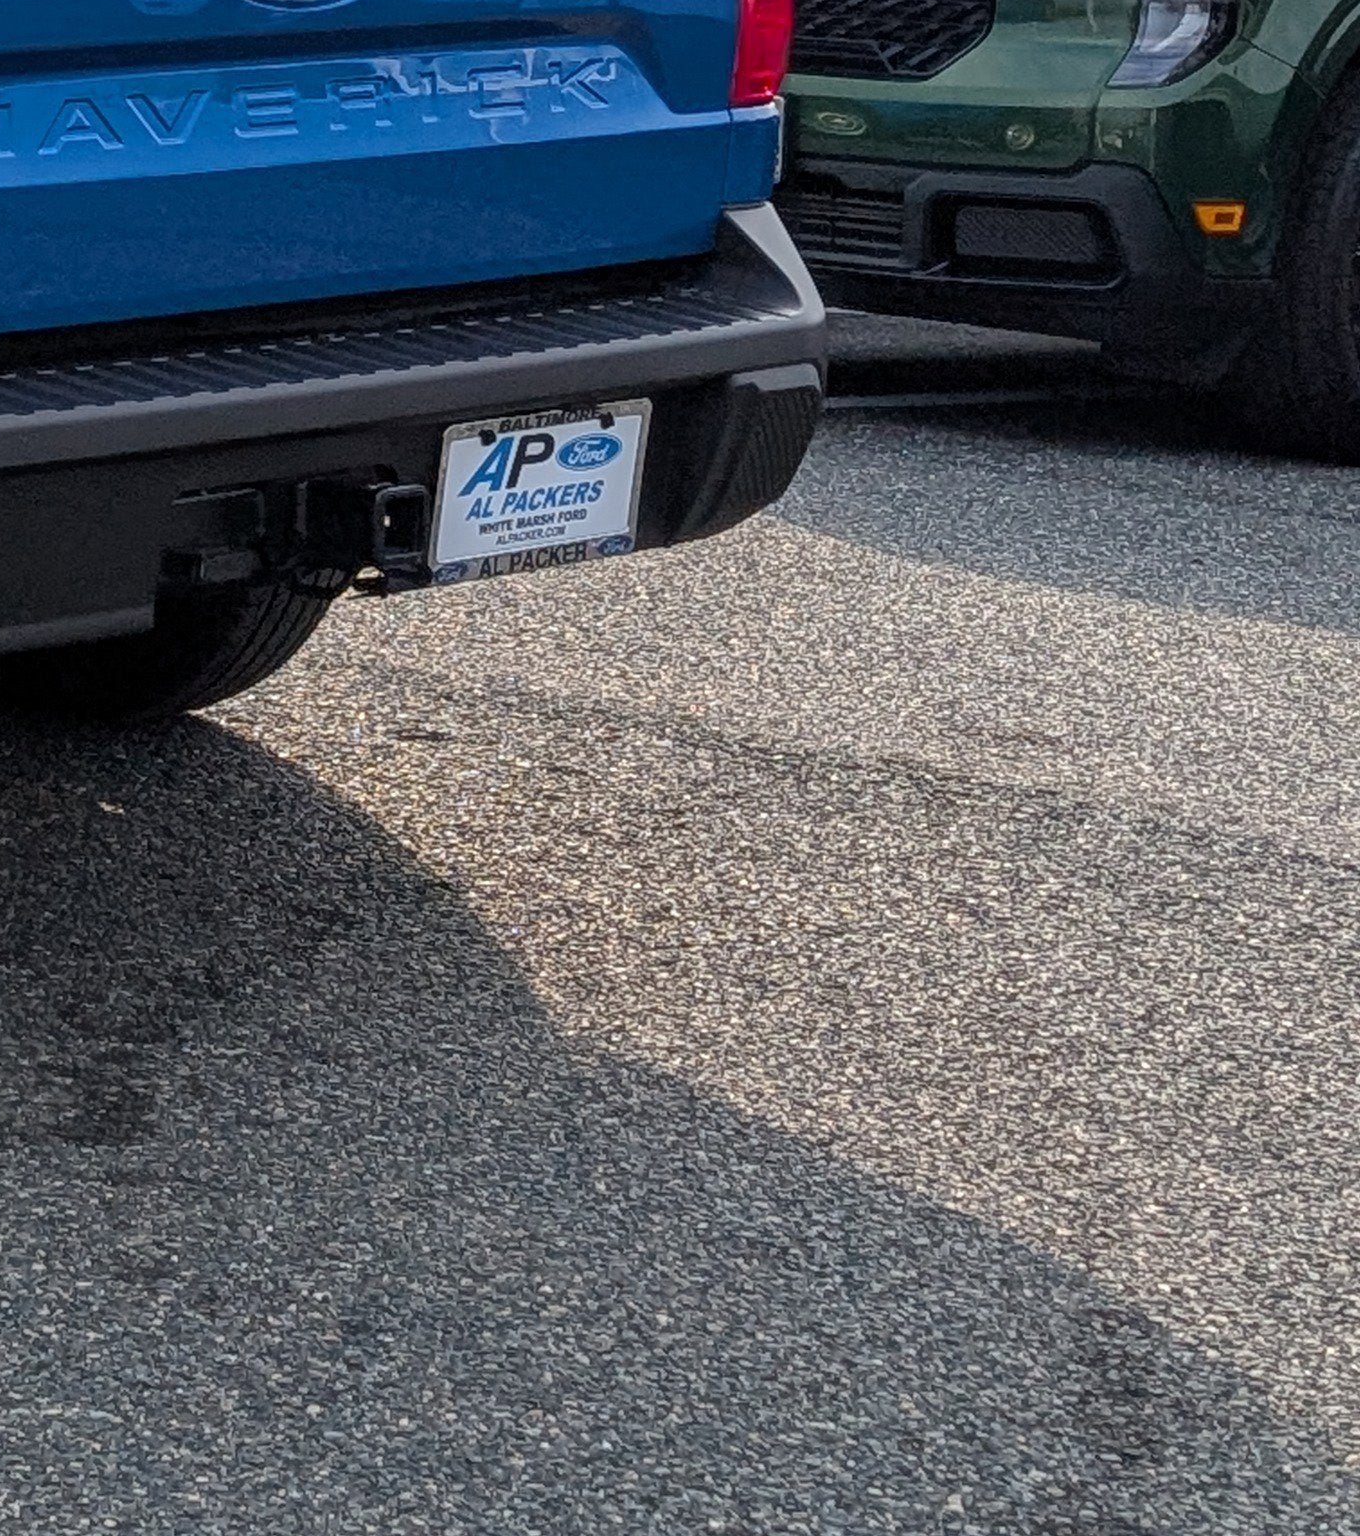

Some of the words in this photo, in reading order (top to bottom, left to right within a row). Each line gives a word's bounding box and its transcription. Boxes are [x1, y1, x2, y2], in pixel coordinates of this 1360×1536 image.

[497, 407, 601, 433] BALTIMORE
[458, 432, 555, 497] AP
[569, 440, 611, 465] Ford
[465, 496, 494, 521] AL
[501, 480, 604, 515] PACKERS
[479, 519, 513, 535] WHITE
[516, 512, 555, 529] MARSH
[558, 508, 587, 523] FORD
[480, 555, 504, 578] AL
[509, 542, 587, 573] PACKER
